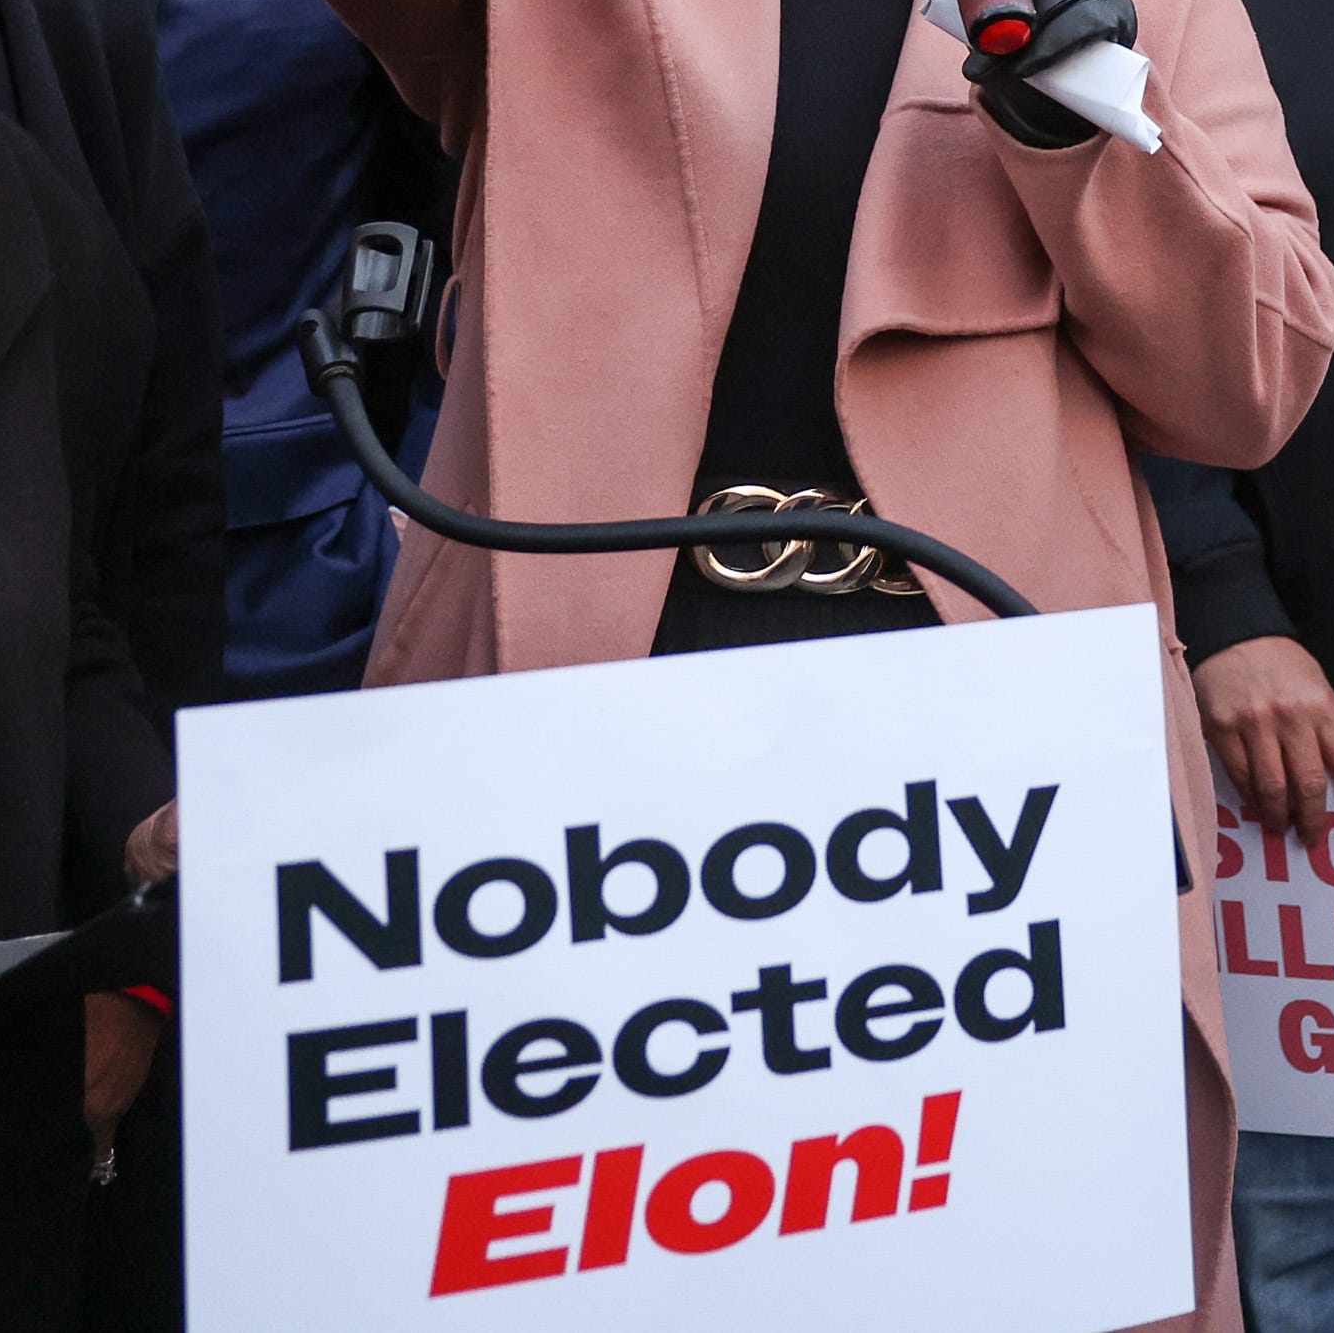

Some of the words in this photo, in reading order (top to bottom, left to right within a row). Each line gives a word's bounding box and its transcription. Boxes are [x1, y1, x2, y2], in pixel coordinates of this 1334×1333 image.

[274, 777, 1060, 985] Nobody
[285, 919, 1067, 1152] Elected
[427, 1089, 963, 1298] Elon!
